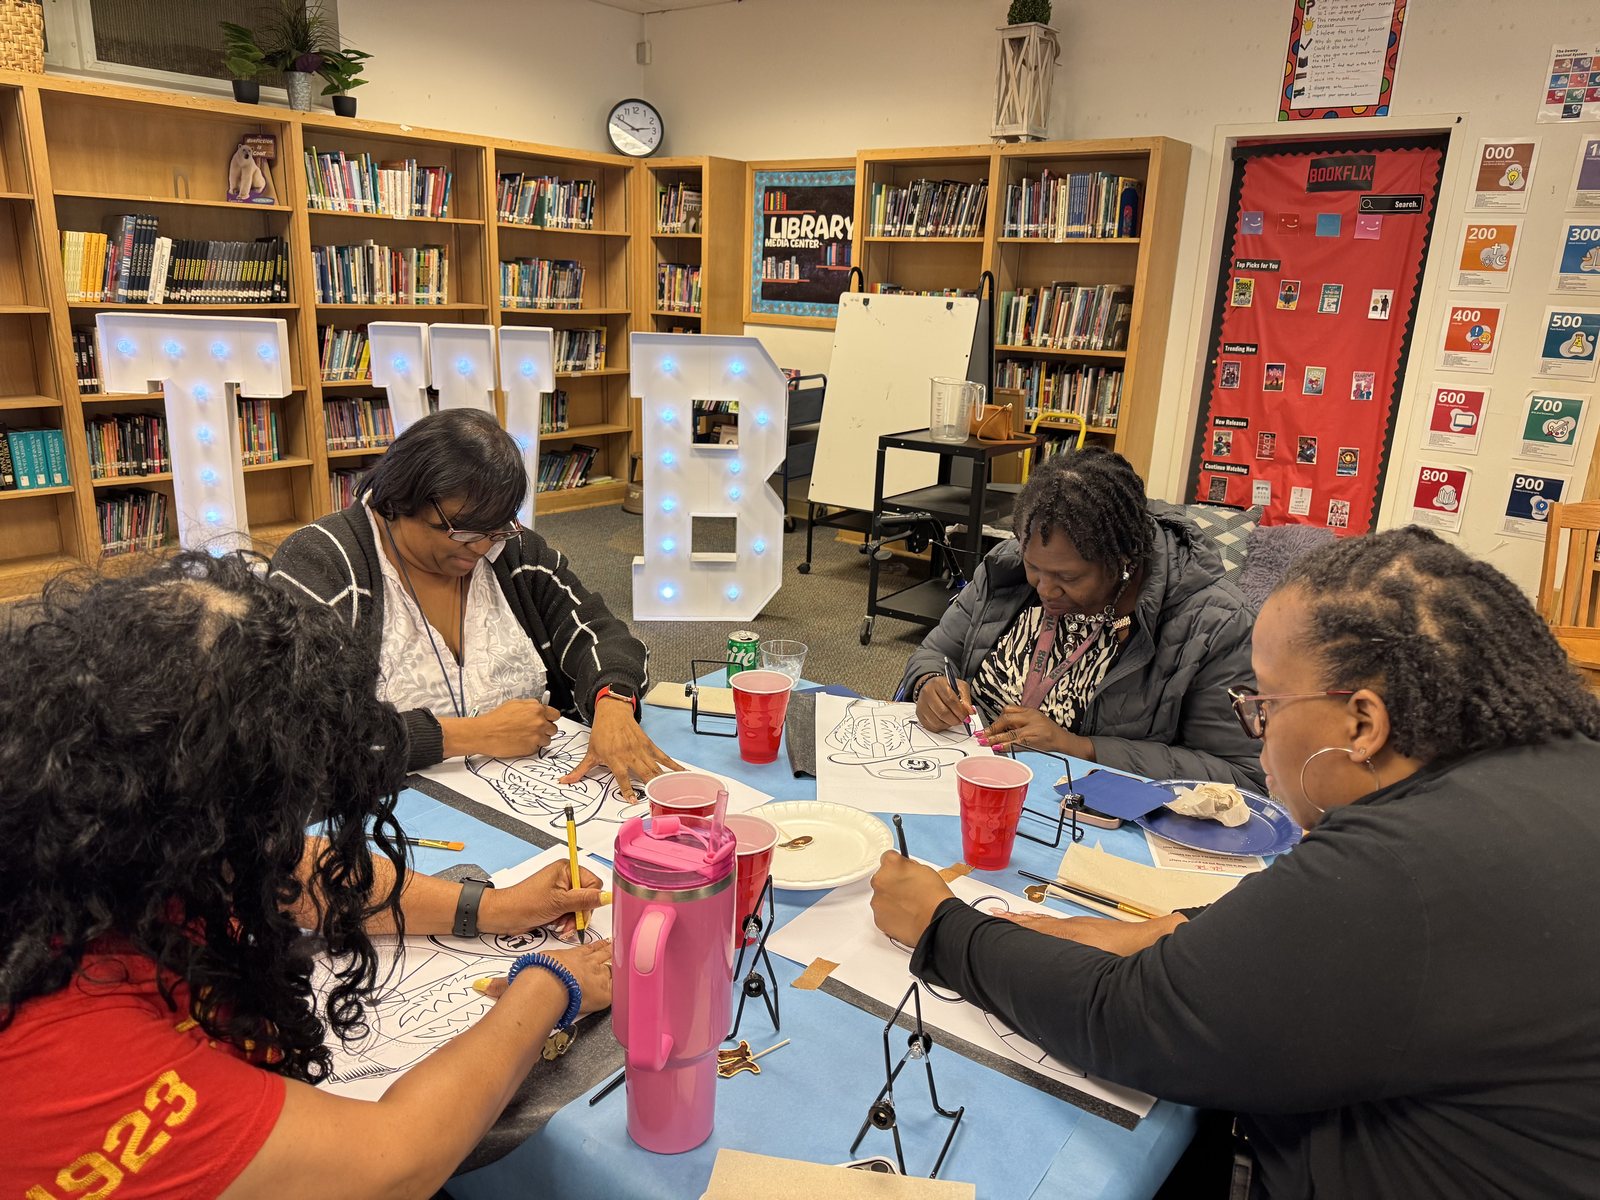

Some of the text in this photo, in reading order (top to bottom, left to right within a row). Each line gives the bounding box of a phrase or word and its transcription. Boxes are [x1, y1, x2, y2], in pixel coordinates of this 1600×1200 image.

[652, 127, 657, 135] 3
[1485, 146, 1514, 159] 000
[1309, 165, 1374, 183] BOOKFLIX
[770, 214, 854, 241] LIBRARY
[1468, 228, 1497, 240] 200
[1569, 228, 1600, 241] 300
[765, 238, 820, 249] MEDIA CENTER
[121, 234, 134, 276] WORLD ATLAS
[1236, 261, 1245, 269] Top
[1452, 310, 1480, 322] 400
[1551, 315, 1582, 328] 500
[1225, 345, 1246, 354] Trending
[1438, 392, 1465, 404] 600
[1533, 399, 1562, 412] 700
[1226, 419, 1247, 427] Releases
[1205, 463, 1248, 474] Continue Watching
[630, 332, 788, 622] B
[1422, 470, 1448, 483] 800
[1515, 477, 1544, 491] 900
